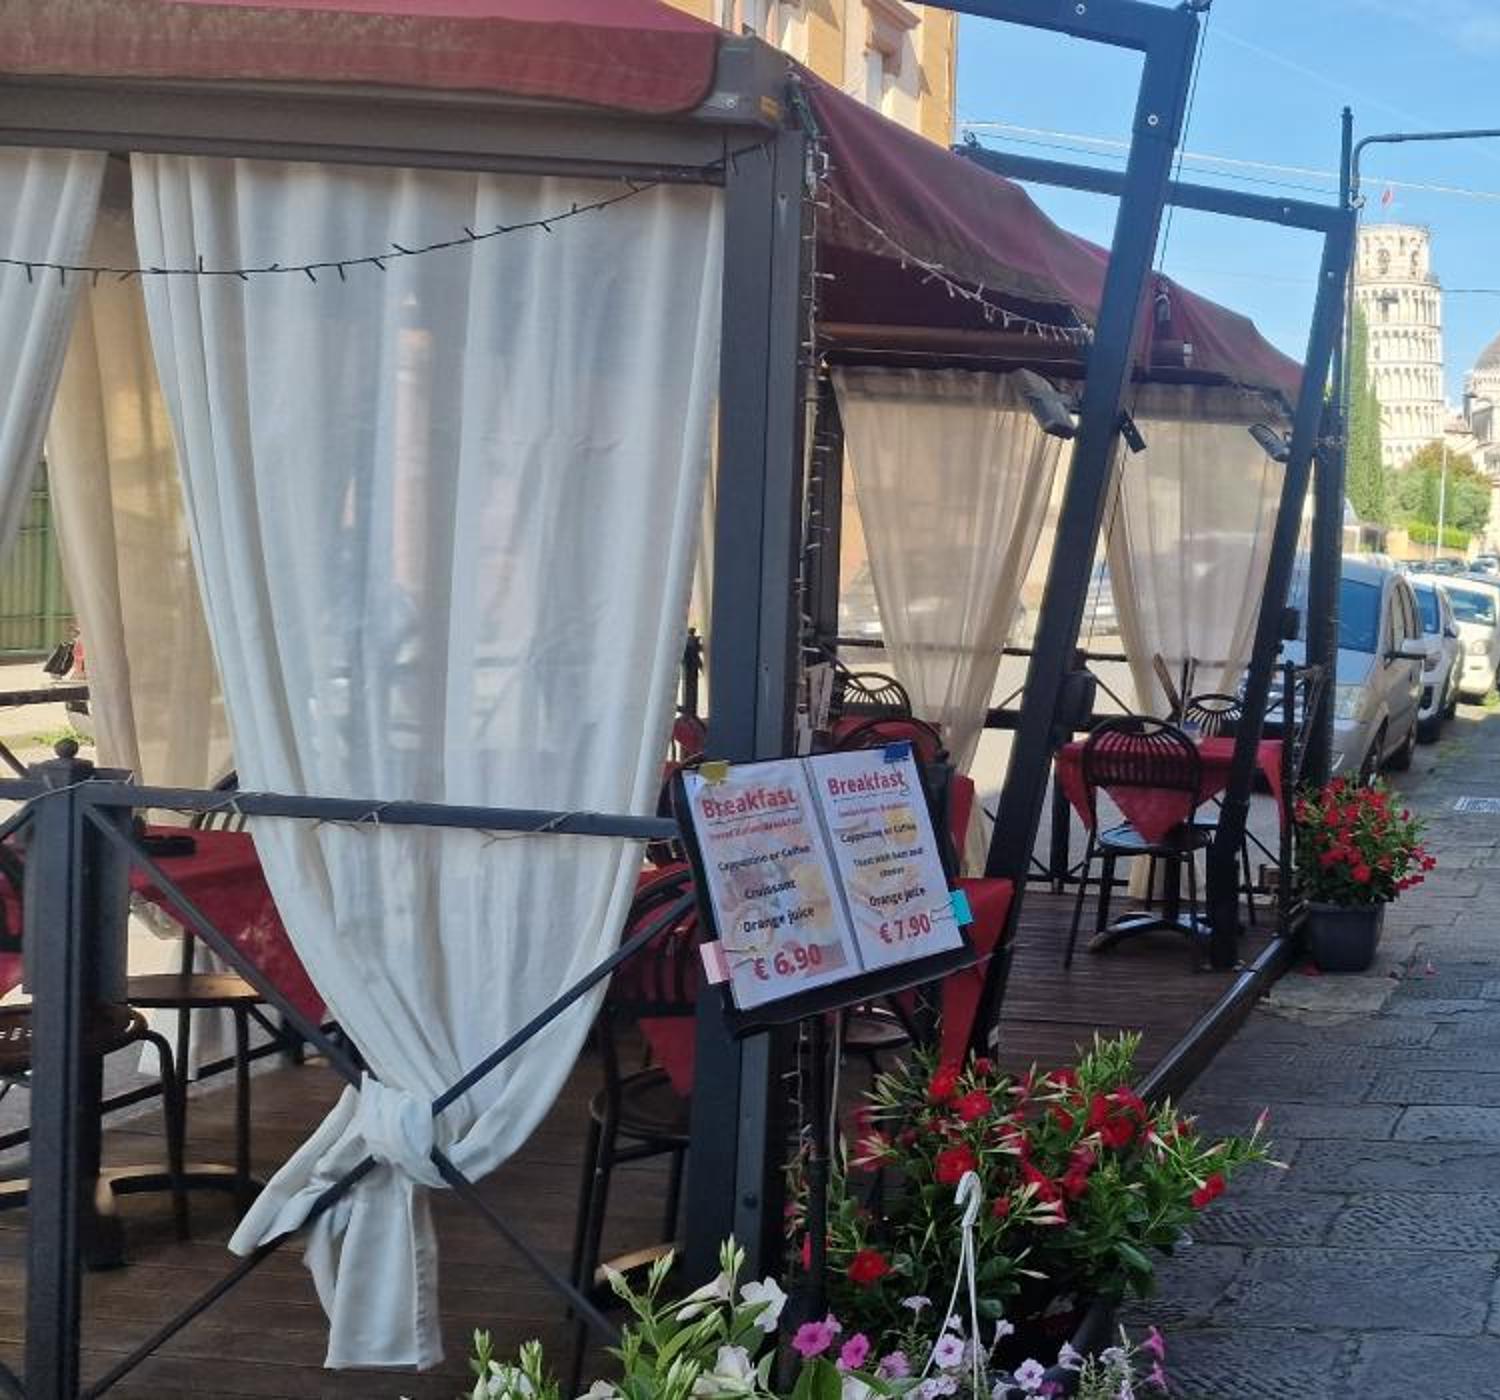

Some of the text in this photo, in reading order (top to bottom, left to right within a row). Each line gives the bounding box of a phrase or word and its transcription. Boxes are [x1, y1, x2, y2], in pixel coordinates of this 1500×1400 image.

[827, 770, 905, 796] Breakfast
[702, 787, 798, 819] Breakfast
[869, 885, 926, 908] Orange juice
[743, 904, 815, 933] Orange juice
[879, 913, 931, 944] € 7.90
[753, 943, 823, 981] € 6.90
